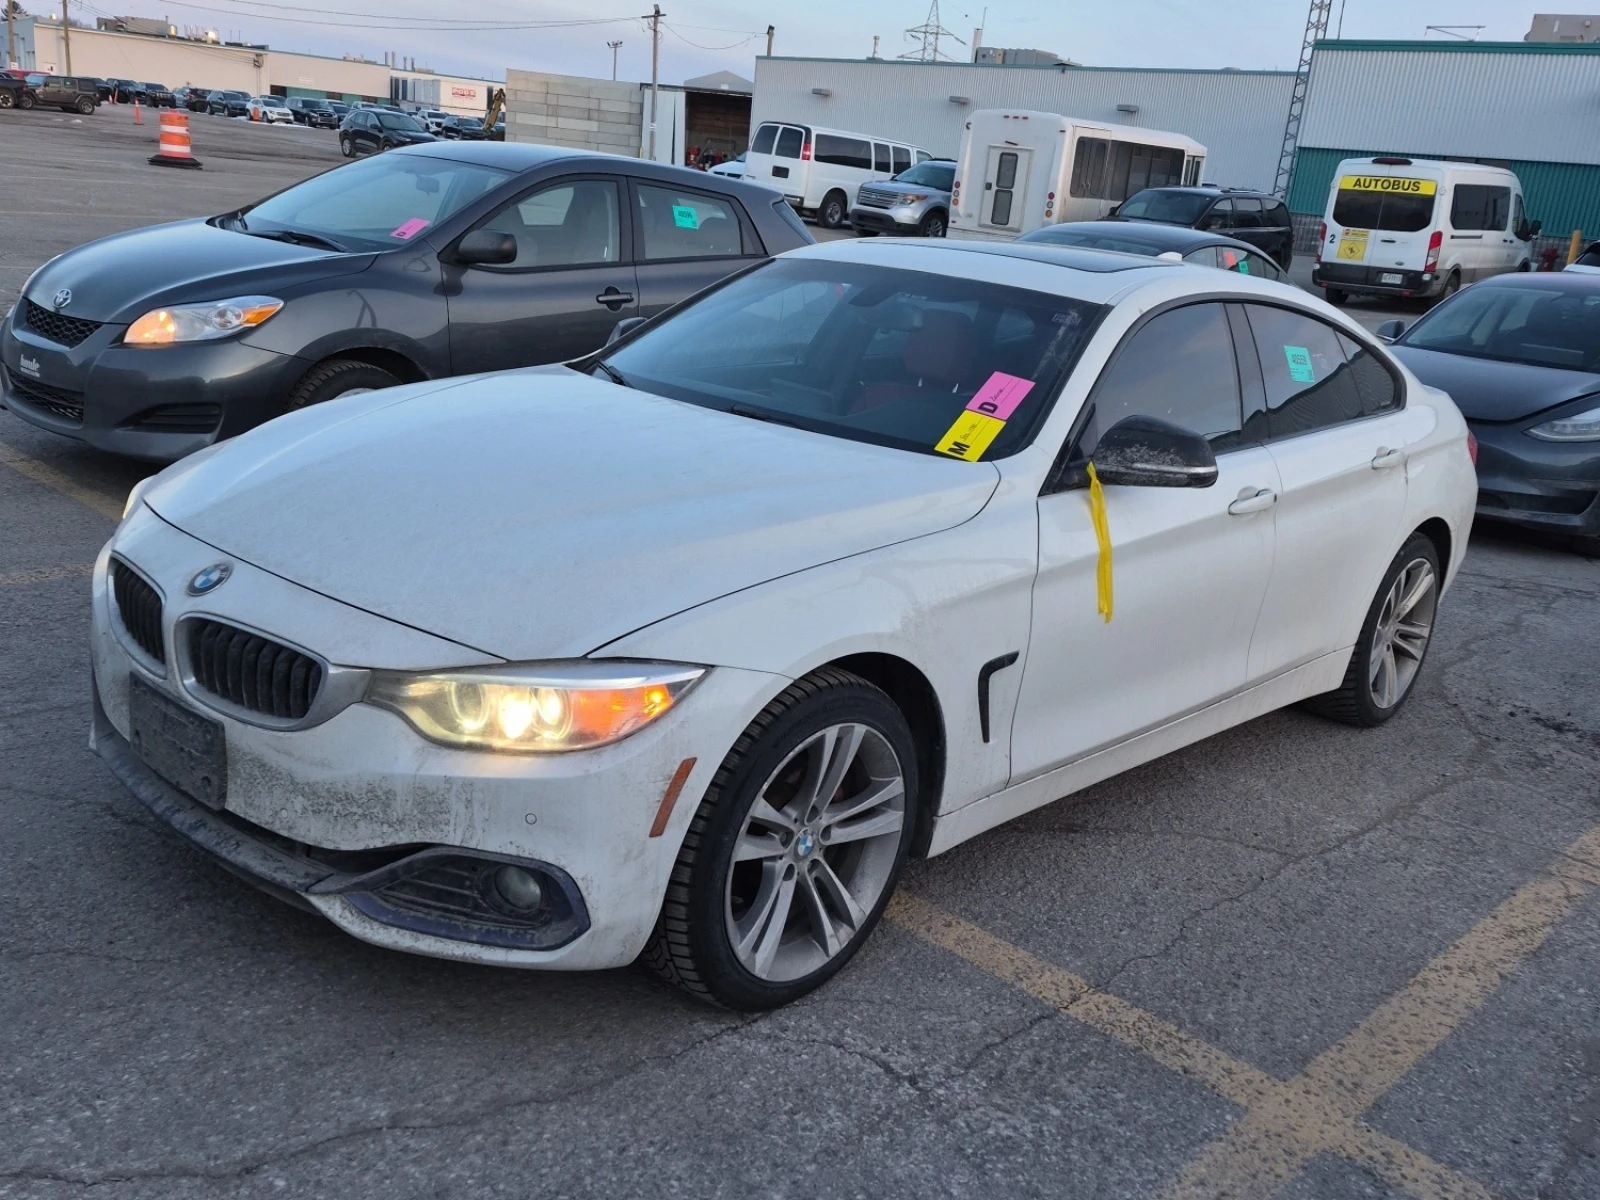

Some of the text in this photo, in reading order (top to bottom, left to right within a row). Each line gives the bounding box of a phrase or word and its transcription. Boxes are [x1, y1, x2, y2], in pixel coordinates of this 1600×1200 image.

[1353, 178, 1421, 192] AUTOBUS
[1329, 234, 1336, 243] 2
[978, 401, 998, 414] D
[947, 441, 971, 456] M
